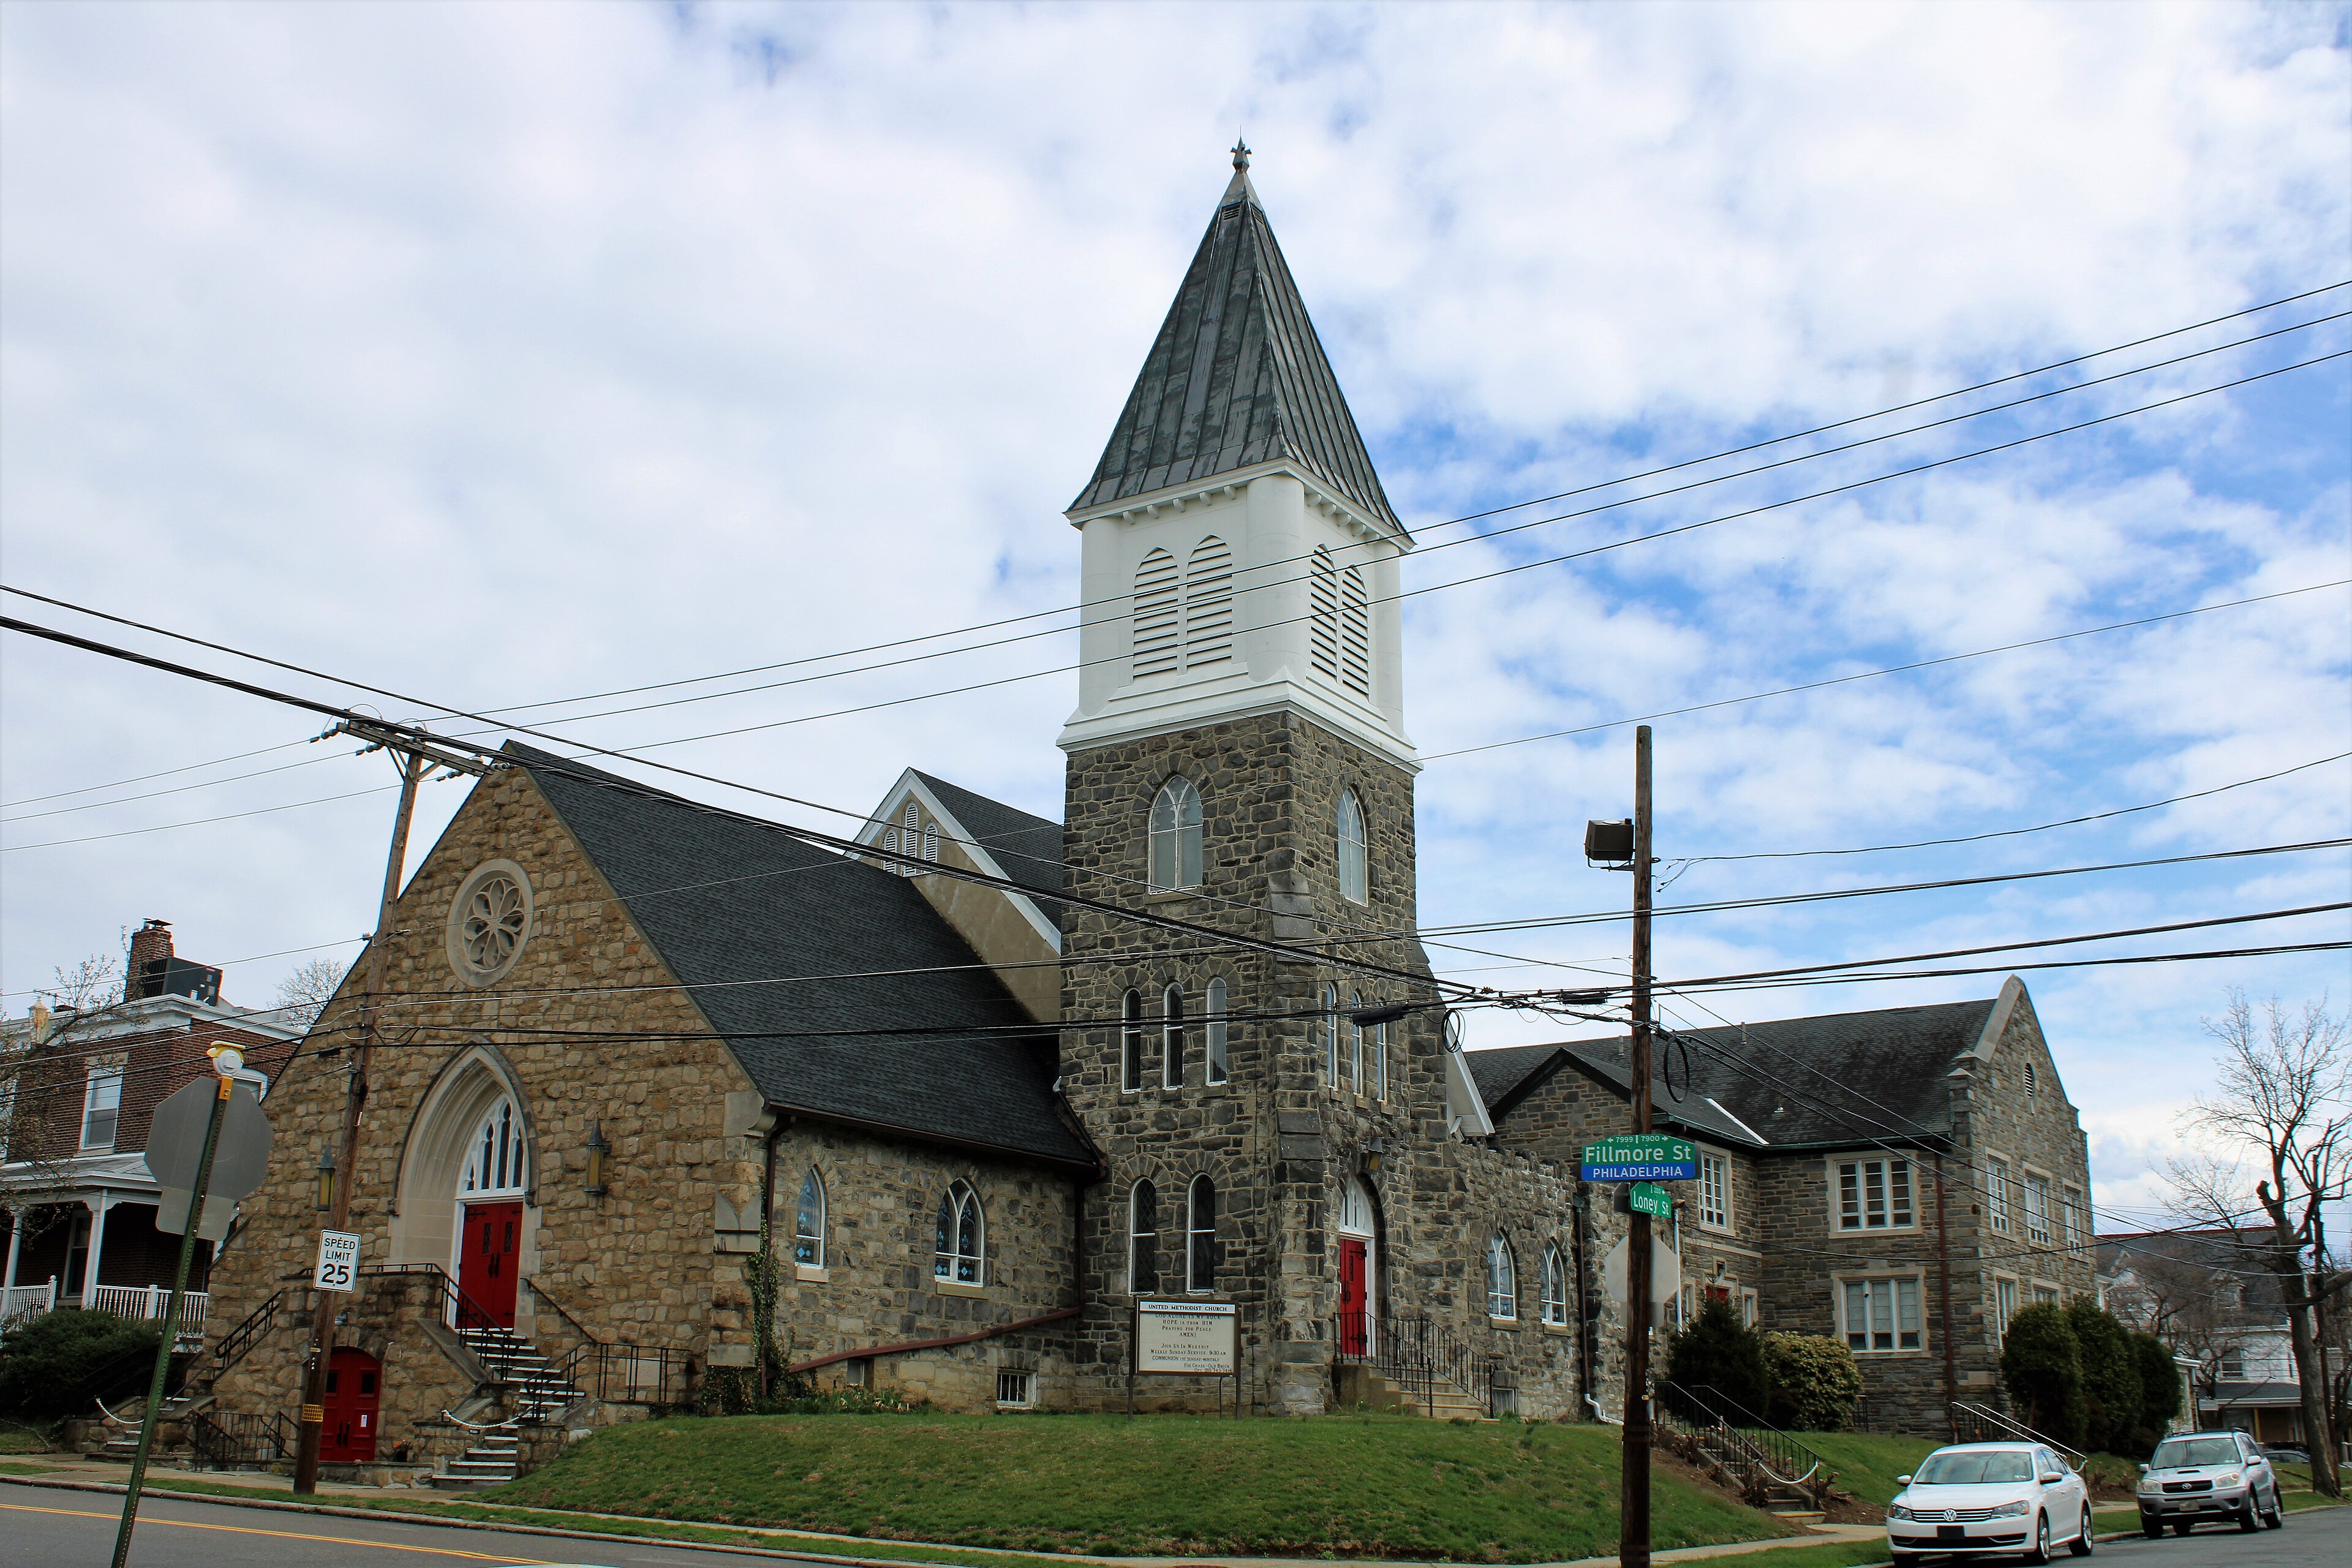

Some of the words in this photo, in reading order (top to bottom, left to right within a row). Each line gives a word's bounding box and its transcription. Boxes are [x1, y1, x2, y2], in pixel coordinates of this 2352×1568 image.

[1586, 1147, 1664, 1163] Fillmore
[1673, 1145, 1691, 1160] St
[1593, 1166, 1683, 1178] PHILADELPHIA
[1634, 1191, 1657, 1214] Loney
[1662, 1200, 1669, 1215] St
[325, 1238, 355, 1250] SPEED
[326, 1250, 351, 1261] LIMIT
[322, 1263, 350, 1285] 25
